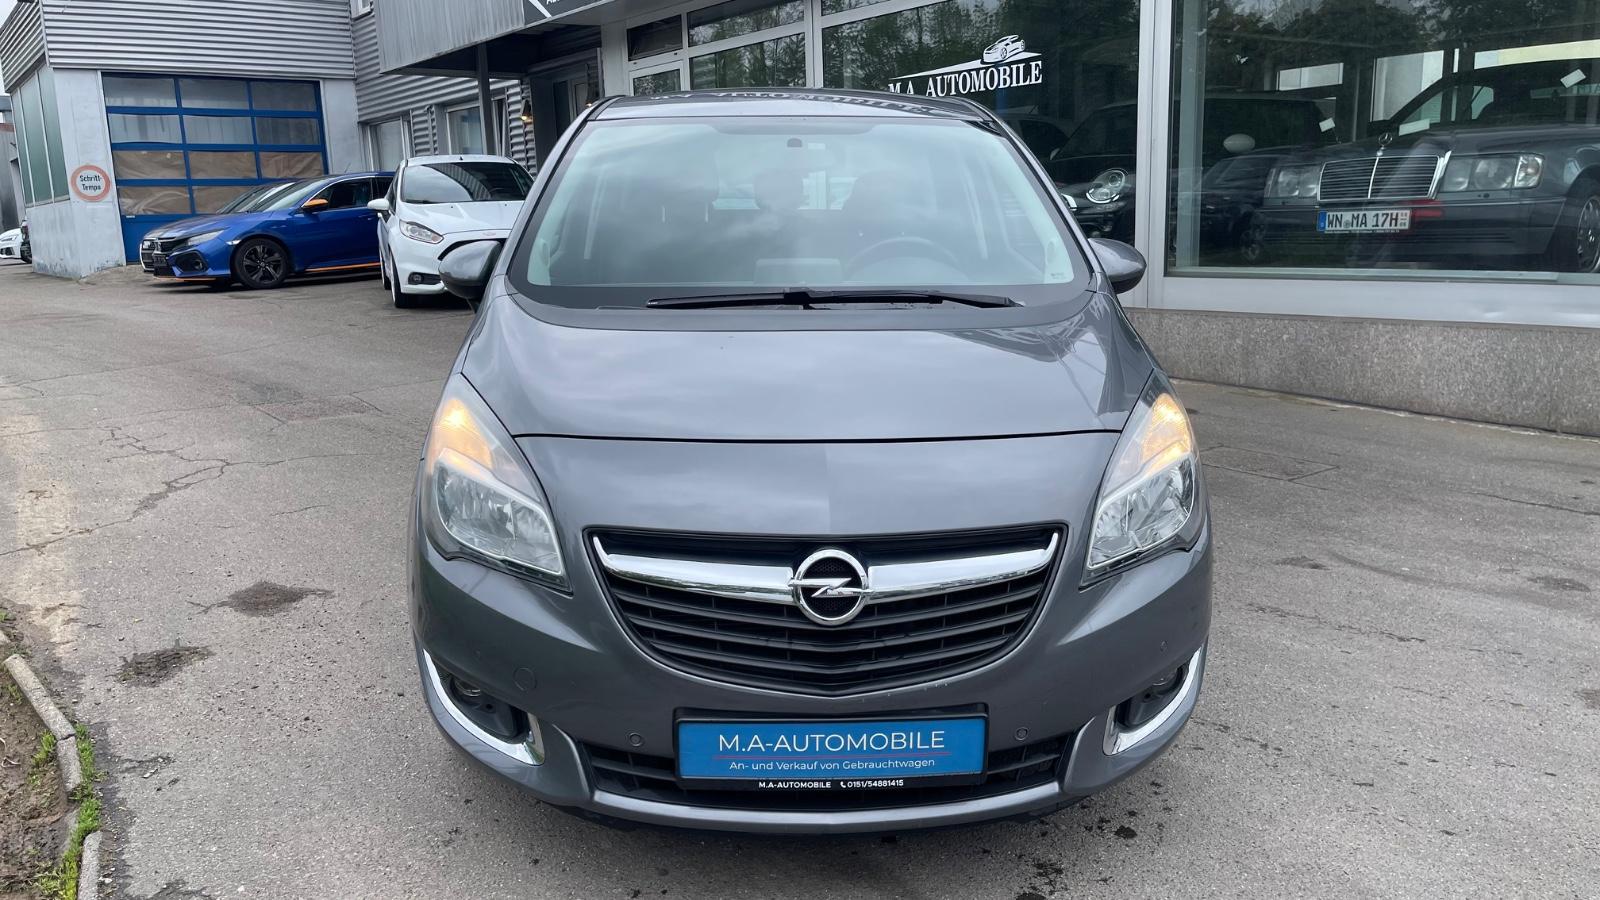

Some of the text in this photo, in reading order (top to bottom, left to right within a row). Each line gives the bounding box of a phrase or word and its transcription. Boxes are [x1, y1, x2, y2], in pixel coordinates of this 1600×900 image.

[926, 61, 1042, 97] AUTOMOBILE
[719, 730, 945, 752] M.A-AUTOMOBILE
[729, 758, 935, 770] An- und Verkauf von Gebrauchtwagen
[759, 779, 904, 789] M.A-AUTOMOBILE 0151/54881415
